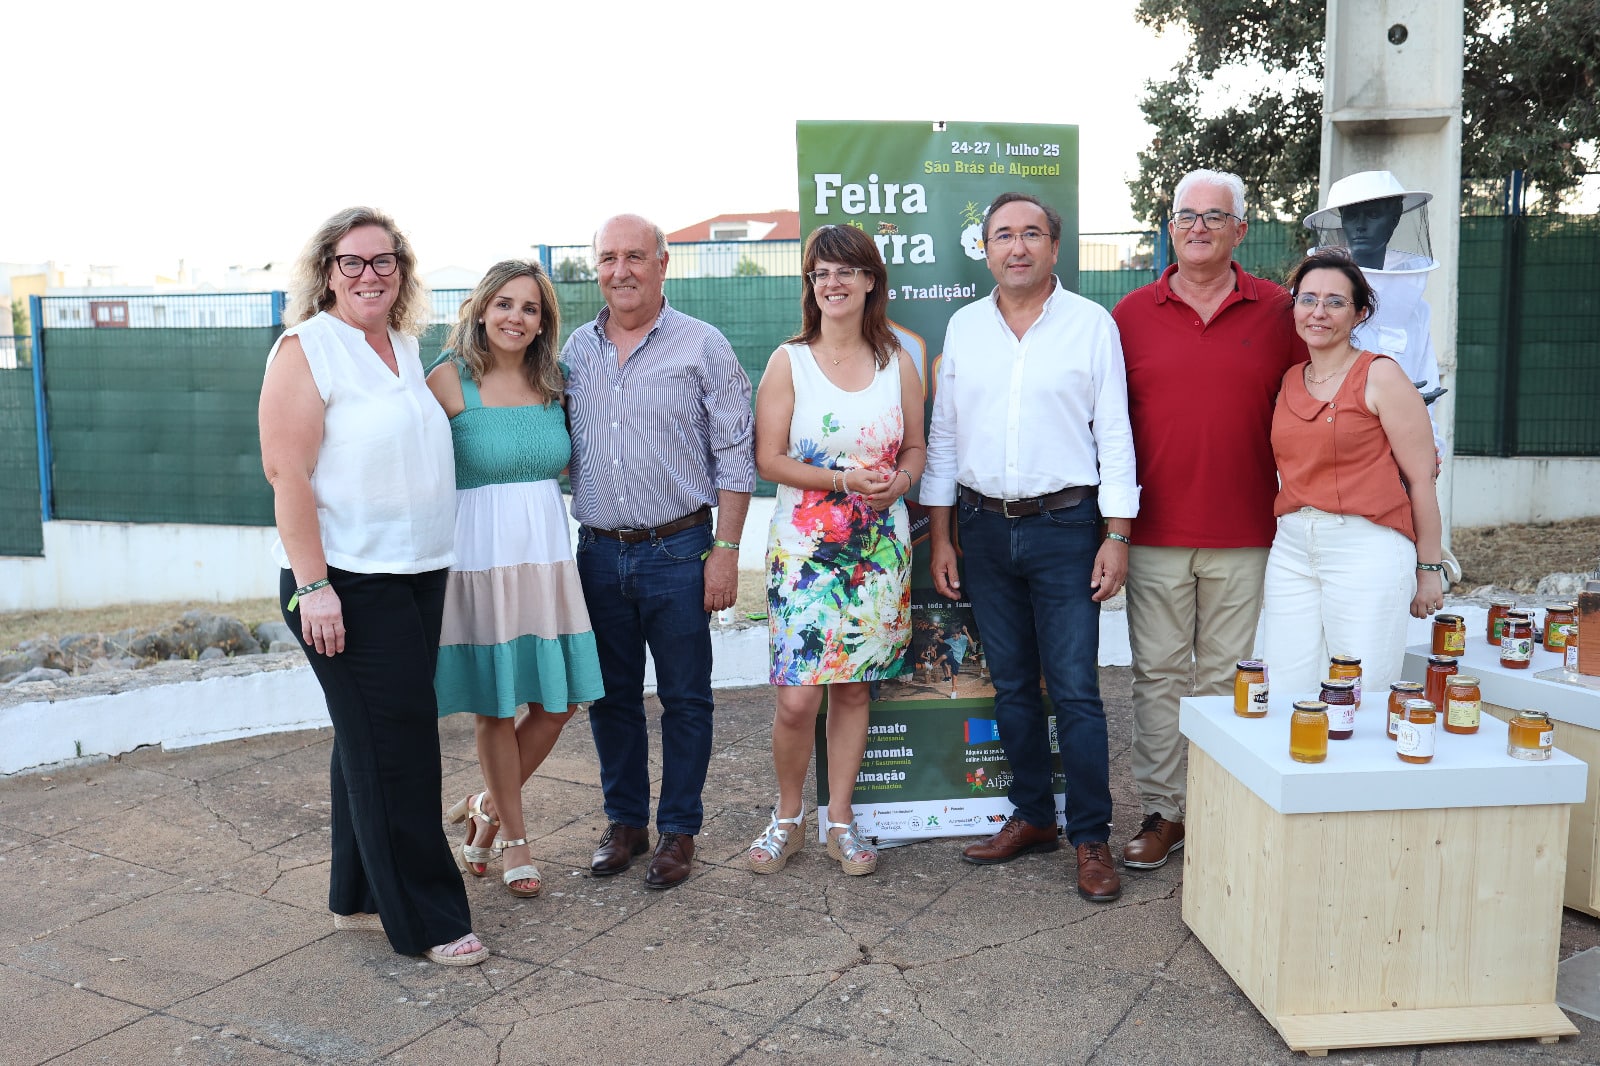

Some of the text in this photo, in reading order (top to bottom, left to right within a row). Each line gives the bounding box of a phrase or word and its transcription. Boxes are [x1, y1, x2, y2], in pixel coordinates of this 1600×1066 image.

[924, 160, 1060, 177] São Brás de Alportel
[814, 173, 928, 215] Feira
[873, 233, 935, 264] rra
[901, 283, 976, 302] Tradição!
